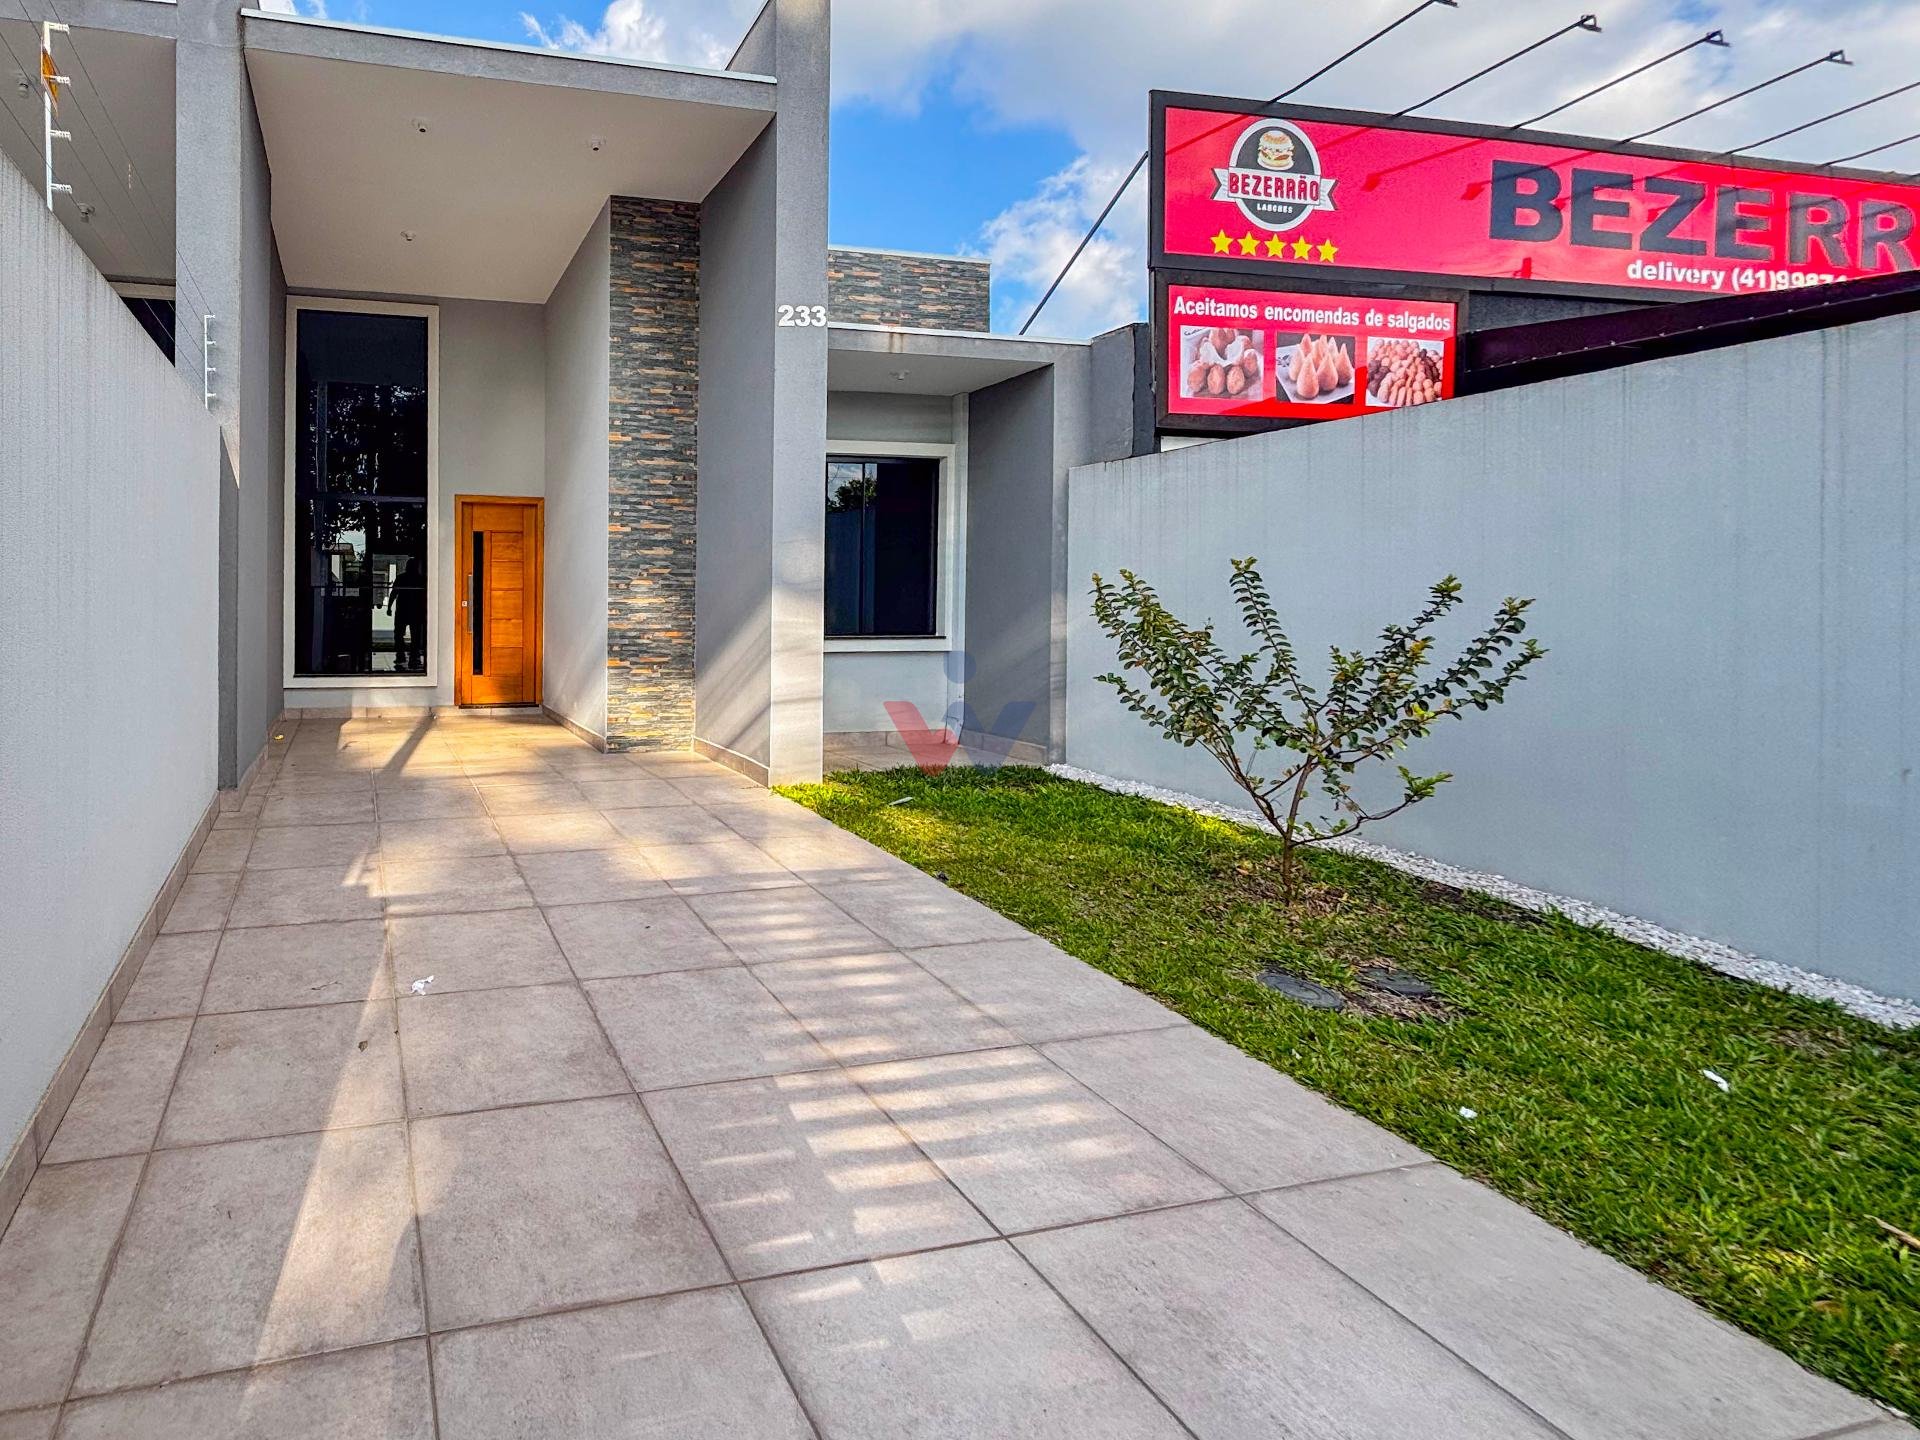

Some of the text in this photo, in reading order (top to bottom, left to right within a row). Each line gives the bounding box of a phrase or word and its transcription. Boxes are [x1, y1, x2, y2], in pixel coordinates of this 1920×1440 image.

[1229, 172, 1319, 202] BEZERRÃO
[1489, 159, 1917, 272] BEZERR
[1627, 259, 1726, 290] delivery
[777, 304, 827, 327] 233
[1173, 296, 1451, 334] Aceitamos encomendas de salgados
